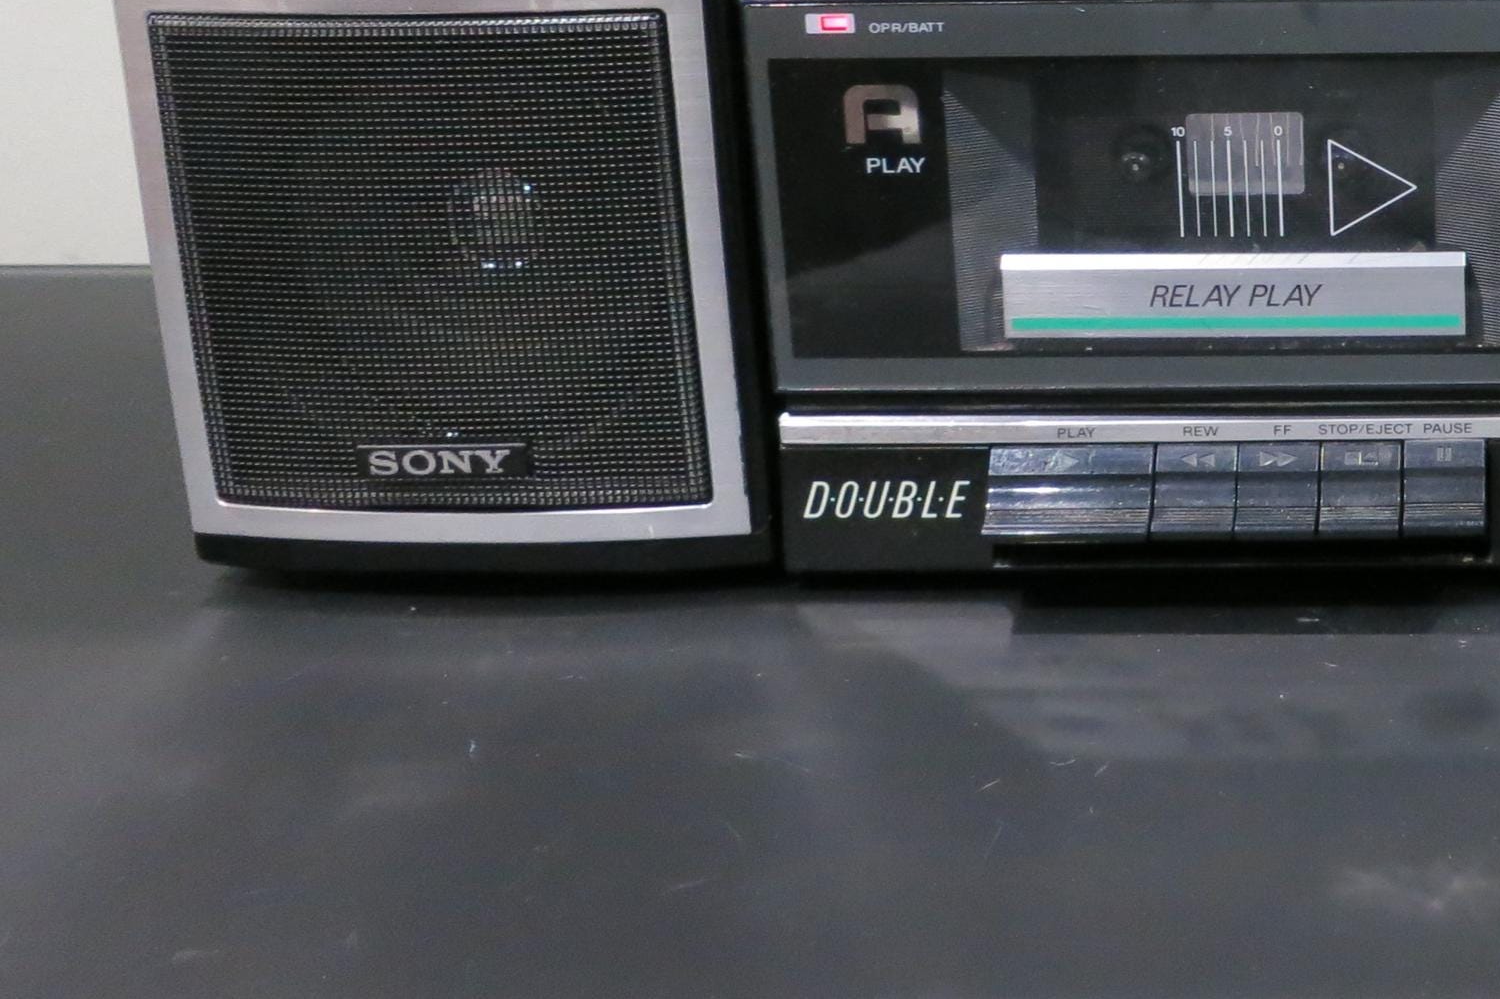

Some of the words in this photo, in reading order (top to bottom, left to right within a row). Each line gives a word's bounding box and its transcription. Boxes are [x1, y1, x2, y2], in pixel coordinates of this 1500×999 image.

[868, 21, 945, 34] OPR/BATT
[843, 84, 922, 144] A
[1171, 126, 1185, 138] 10
[1224, 126, 1232, 137] 5
[1273, 125, 1283, 136] 0
[866, 157, 925, 174] PLAY
[1150, 284, 1241, 307] RELAY
[1248, 283, 1323, 307] PLAY
[1057, 427, 1096, 439] PLAY
[1182, 426, 1219, 437] REW
[1273, 425, 1291, 436] FF
[1318, 423, 1413, 435] STOP/EJECT
[1423, 423, 1473, 434] PAUSE
[368, 449, 510, 476] SONY
